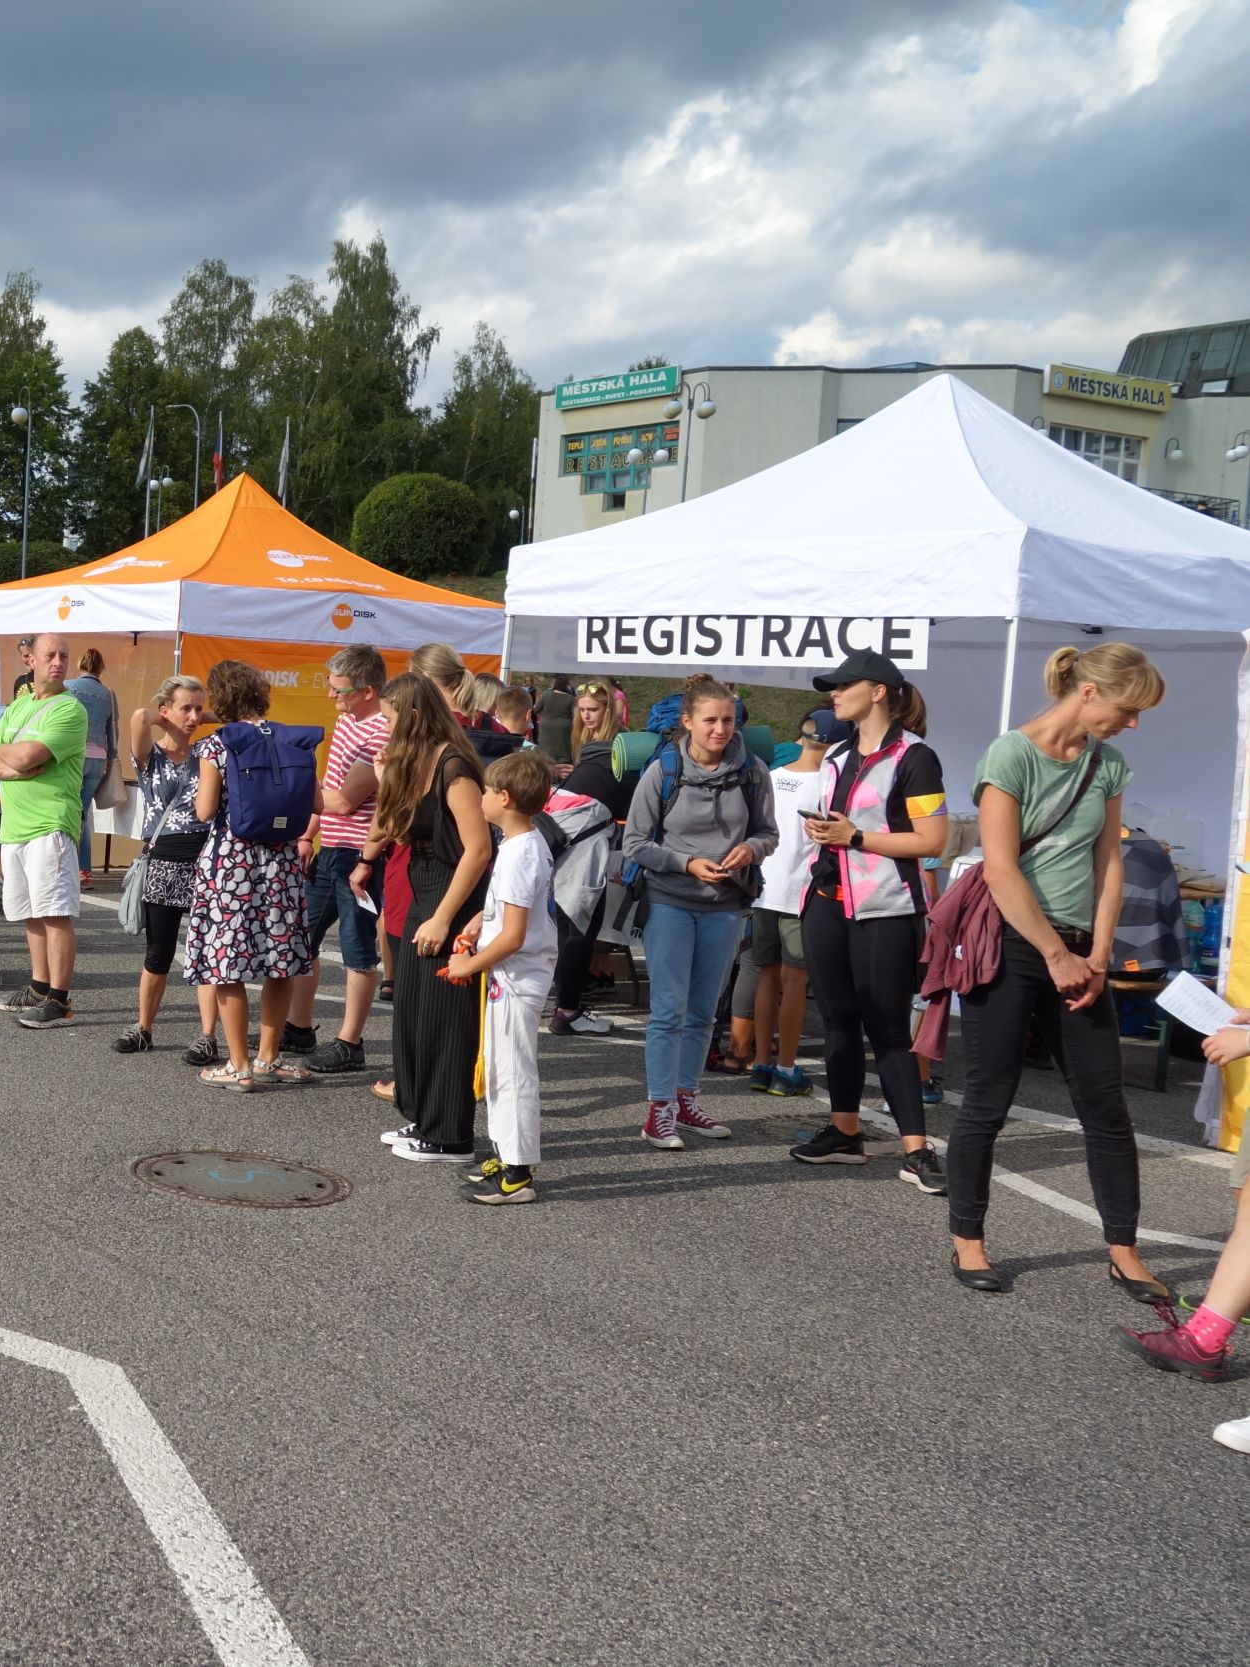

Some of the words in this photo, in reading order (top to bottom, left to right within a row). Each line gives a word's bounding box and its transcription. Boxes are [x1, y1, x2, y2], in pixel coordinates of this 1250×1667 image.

[562, 376, 625, 396] MĚSTSKÁ
[630, 371, 667, 386] HALA
[1068, 373, 1128, 400] MĚSTSKÁ
[1132, 387, 1165, 406] HALA
[561, 395, 601, 406] RESTAURACE
[605, 391, 625, 400] BUFET
[566, 447, 679, 472] RESTAUAE
[334, 608, 376, 619] SUNDISK
[585, 614, 914, 660] REGISTRACE
[262, 670, 300, 688] DISK
